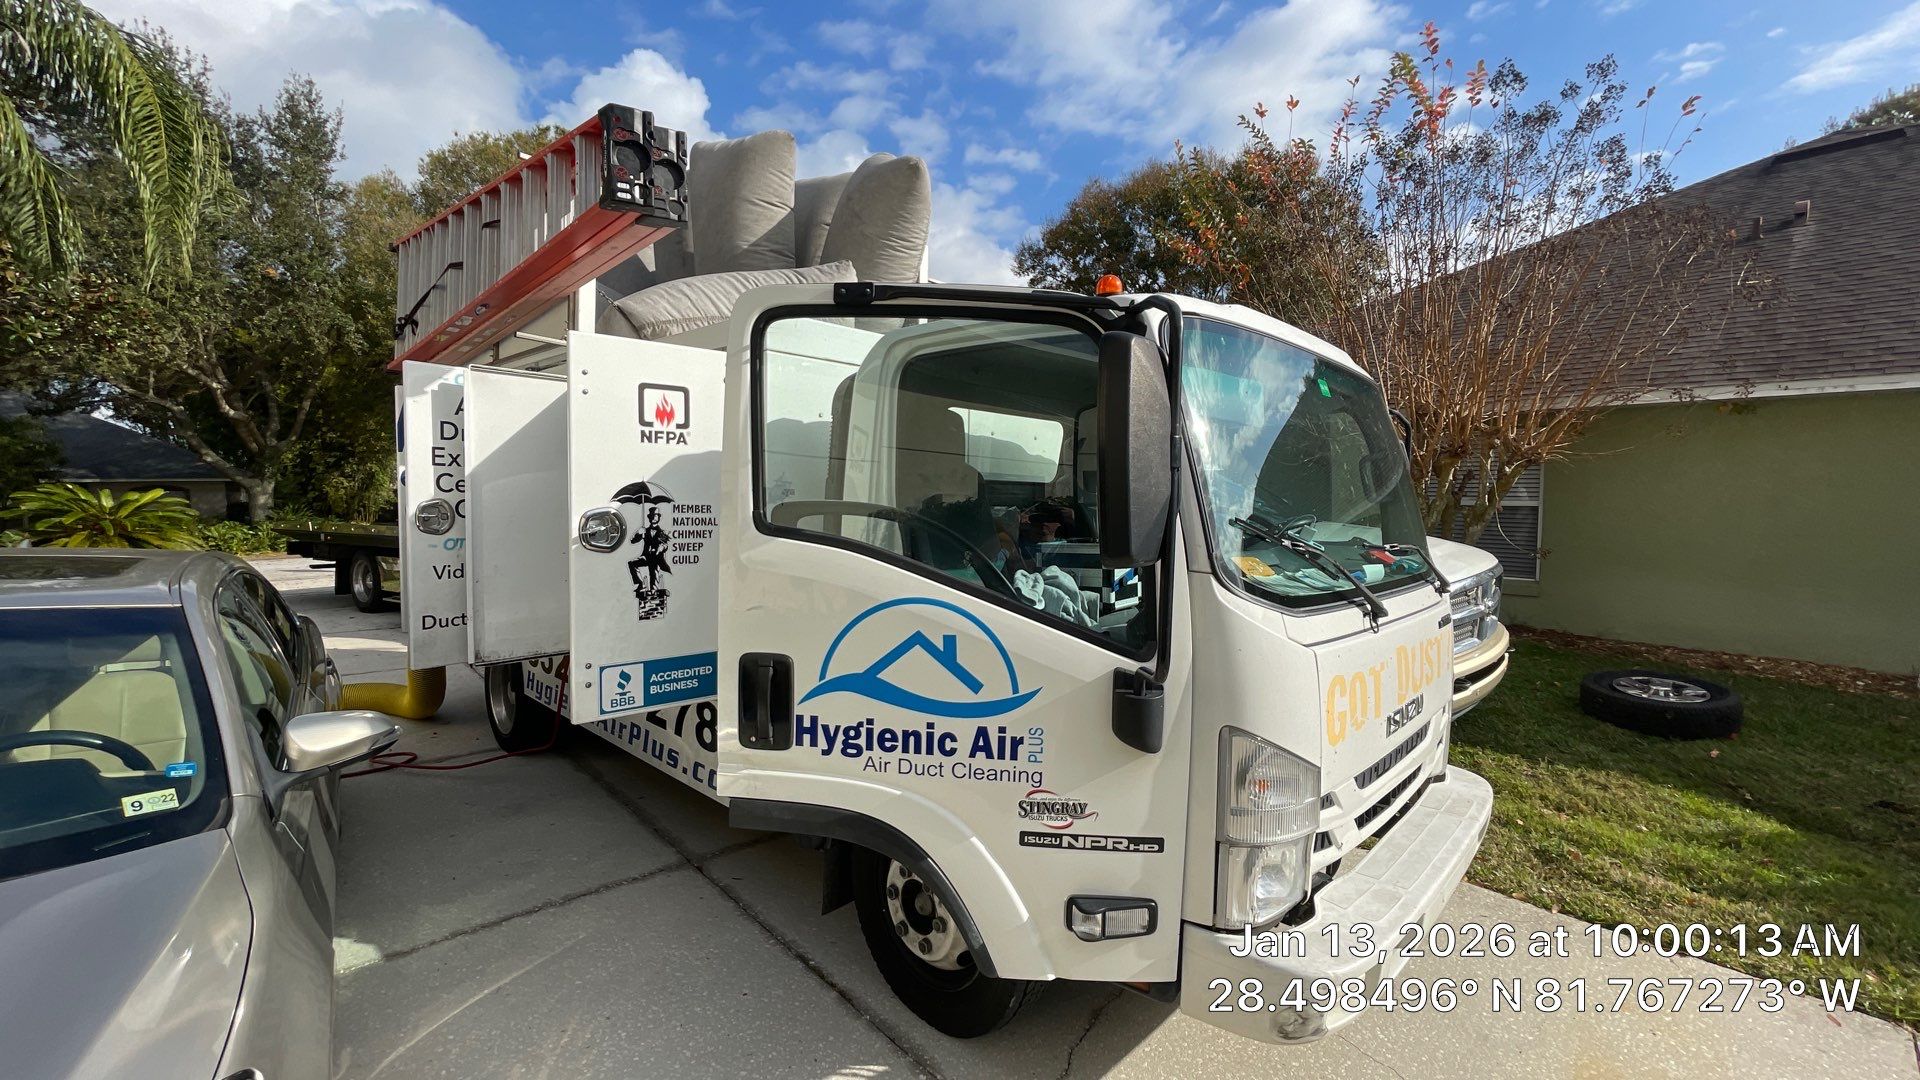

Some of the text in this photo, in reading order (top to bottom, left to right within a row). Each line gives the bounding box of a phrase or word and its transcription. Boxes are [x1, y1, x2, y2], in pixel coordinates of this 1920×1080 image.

[640, 429, 688, 445] NFPA
[432, 446, 462, 467] Ex
[673, 504, 712, 513] MEMBER
[673, 517, 718, 527] NATIONAL
[672, 530, 713, 539] CHIMNEY
[672, 542, 704, 552] SWEEP
[672, 555, 700, 565] GUILD
[433, 563, 464, 580] Vid
[422, 613, 467, 631] Duct
[650, 665, 713, 683] ACCREDITED
[527, 670, 570, 711] Hygie
[650, 679, 699, 694] BUSINESS
[610, 696, 636, 708] BBB
[1326, 660, 1386, 747] GOT
[1386, 691, 1424, 739] ISUZU
[795, 714, 1024, 761] Hygienic Air
[1028, 727, 1044, 763] PLUS
[863, 756, 1043, 788] Air Duct Cleaning
[131, 800, 143, 812] 9
[161, 793, 176, 803] 22
[1018, 799, 1088, 818] STINGRAY
[1024, 835, 1060, 845] ISUZU
